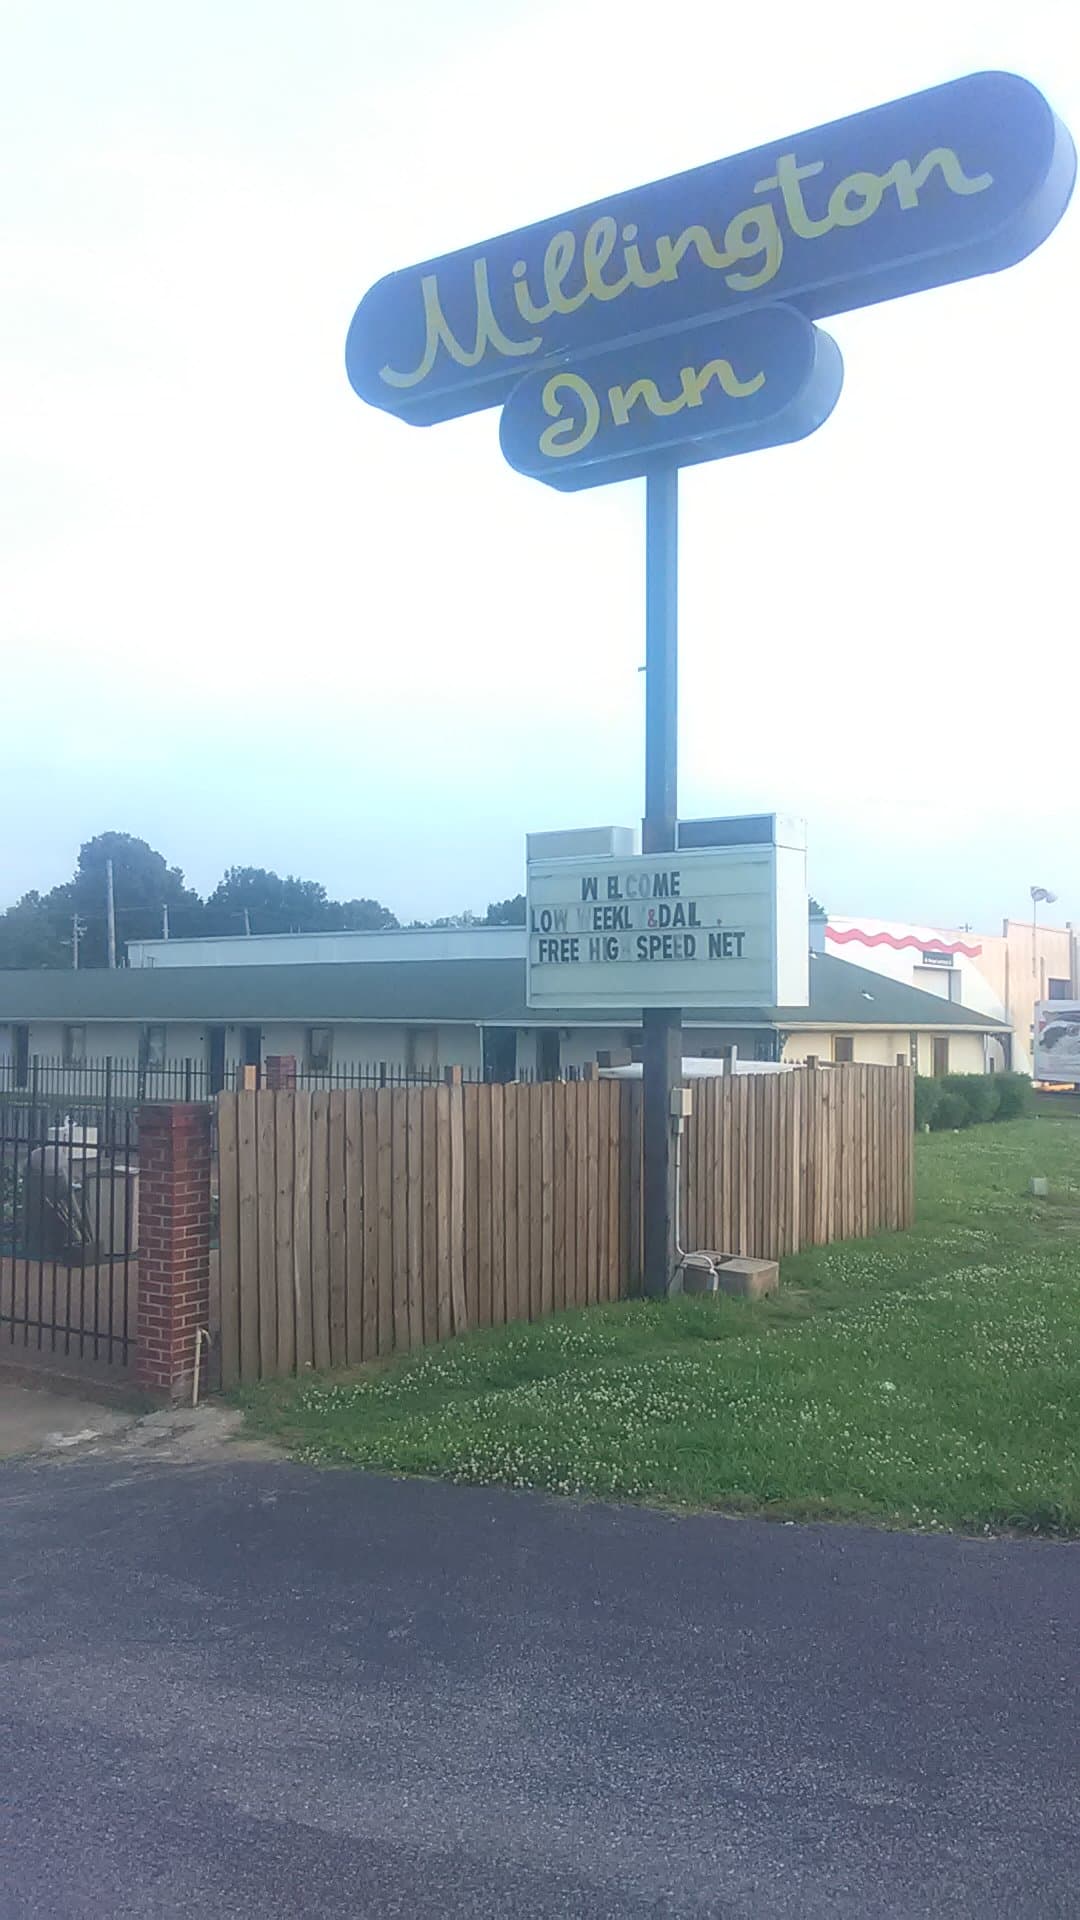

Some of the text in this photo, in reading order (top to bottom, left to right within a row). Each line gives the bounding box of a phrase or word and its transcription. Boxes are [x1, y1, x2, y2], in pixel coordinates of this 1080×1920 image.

[379, 146, 993, 388] Millington
[539, 359, 766, 458] Inn
[582, 871, 681, 900] WELCOME
[531, 907, 567, 932] LOW
[539, 938, 579, 962] FREE
[637, 934, 696, 960] SPEED
[708, 932, 746, 958] NET
